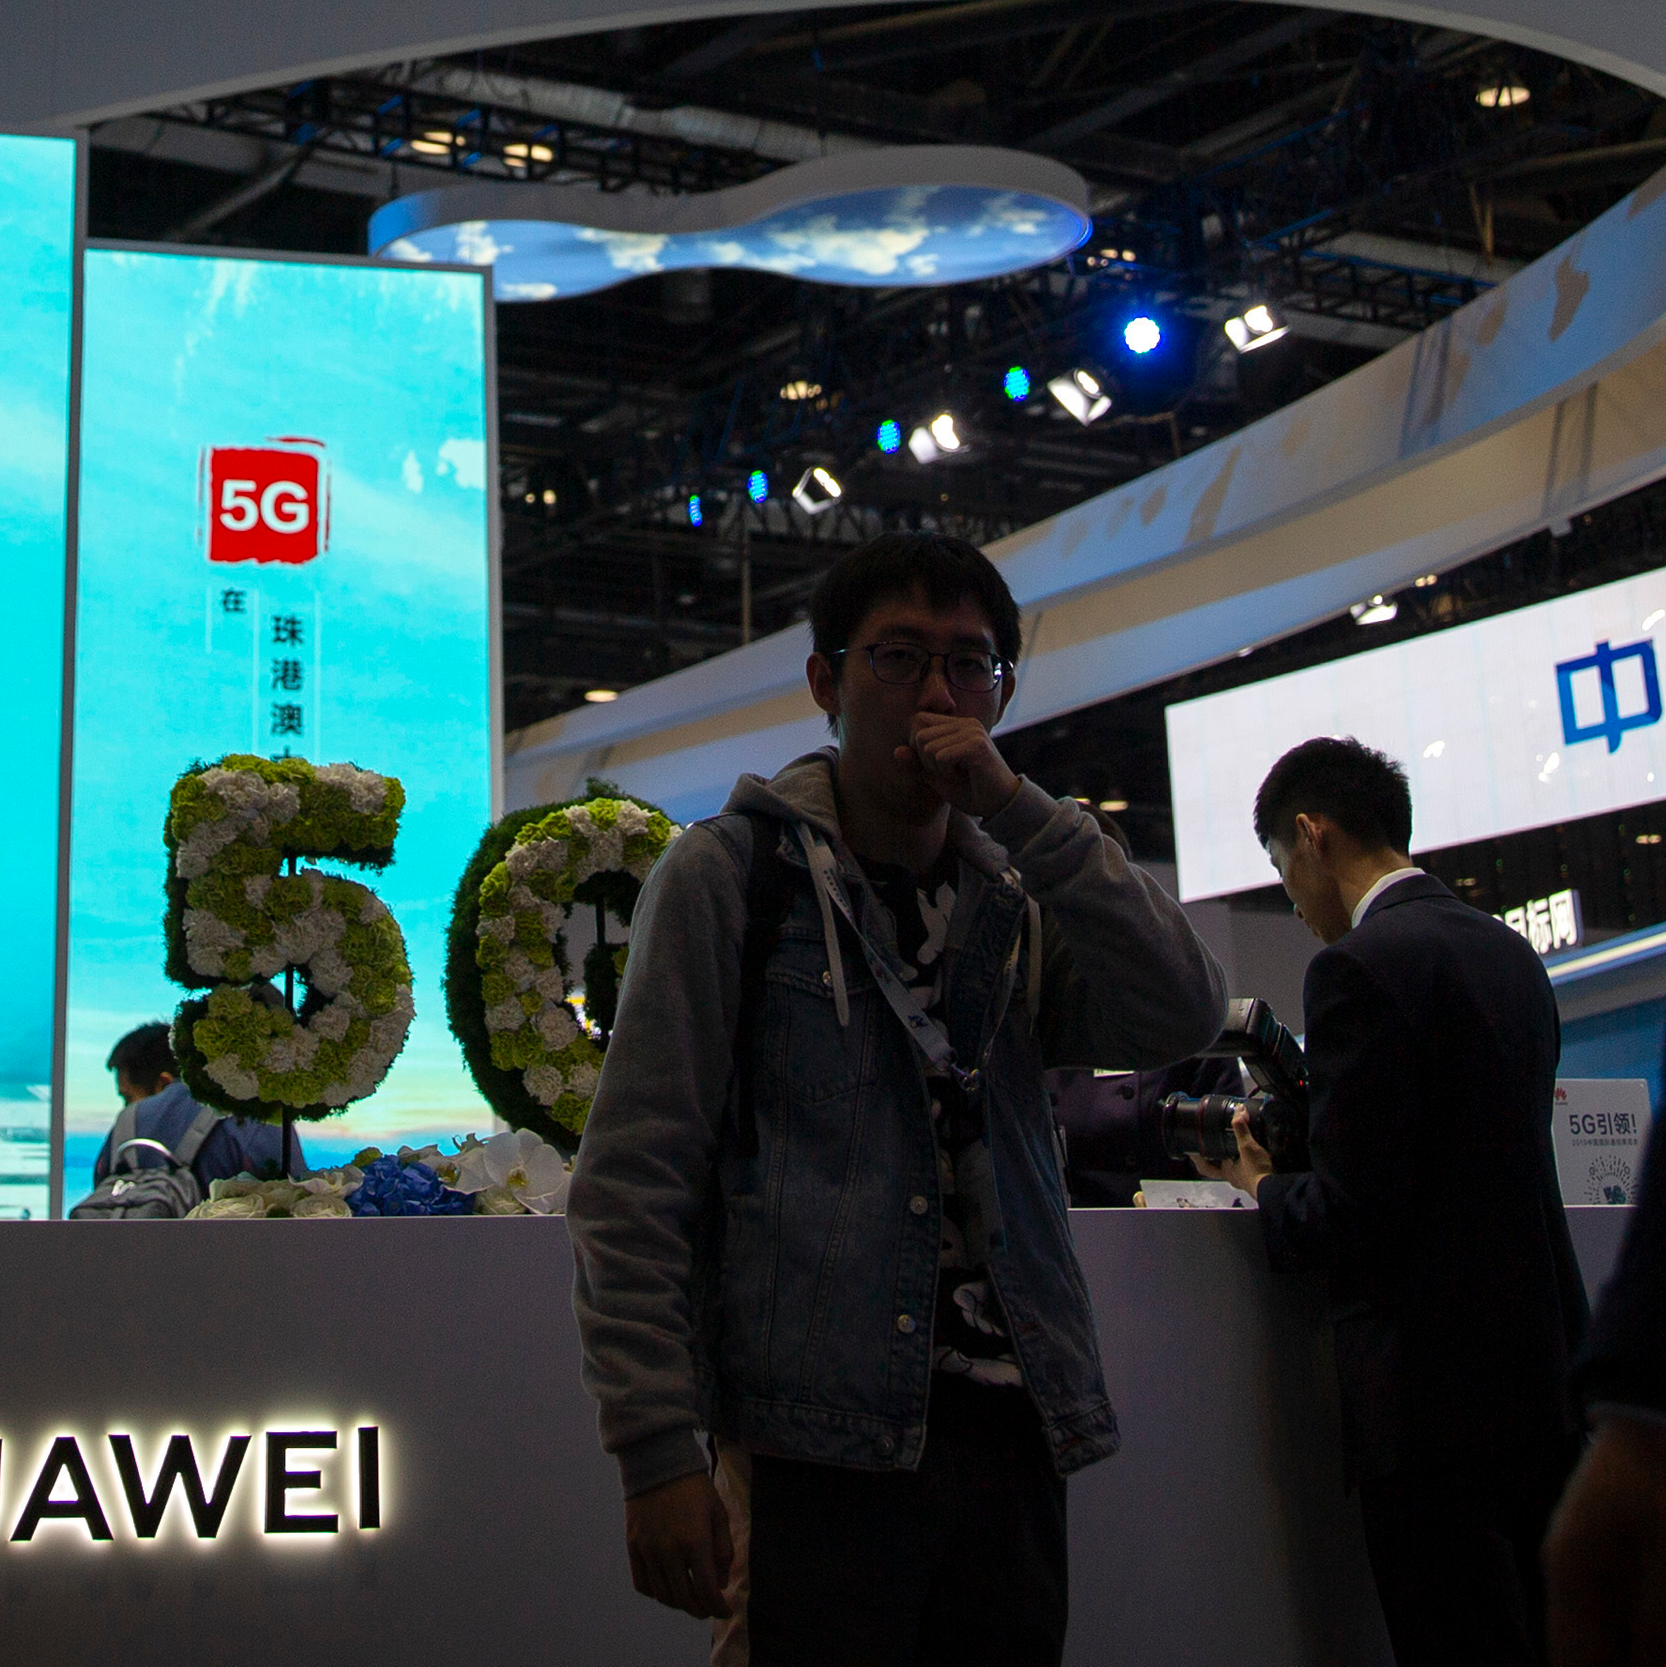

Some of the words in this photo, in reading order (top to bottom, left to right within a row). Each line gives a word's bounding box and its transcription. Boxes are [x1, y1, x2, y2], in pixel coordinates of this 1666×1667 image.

[219, 479, 310, 534] 5G
[220, 588, 246, 614] 在
[269, 614, 305, 760] 珠港澳
[1568, 1112, 1638, 1136] 5G引领!
